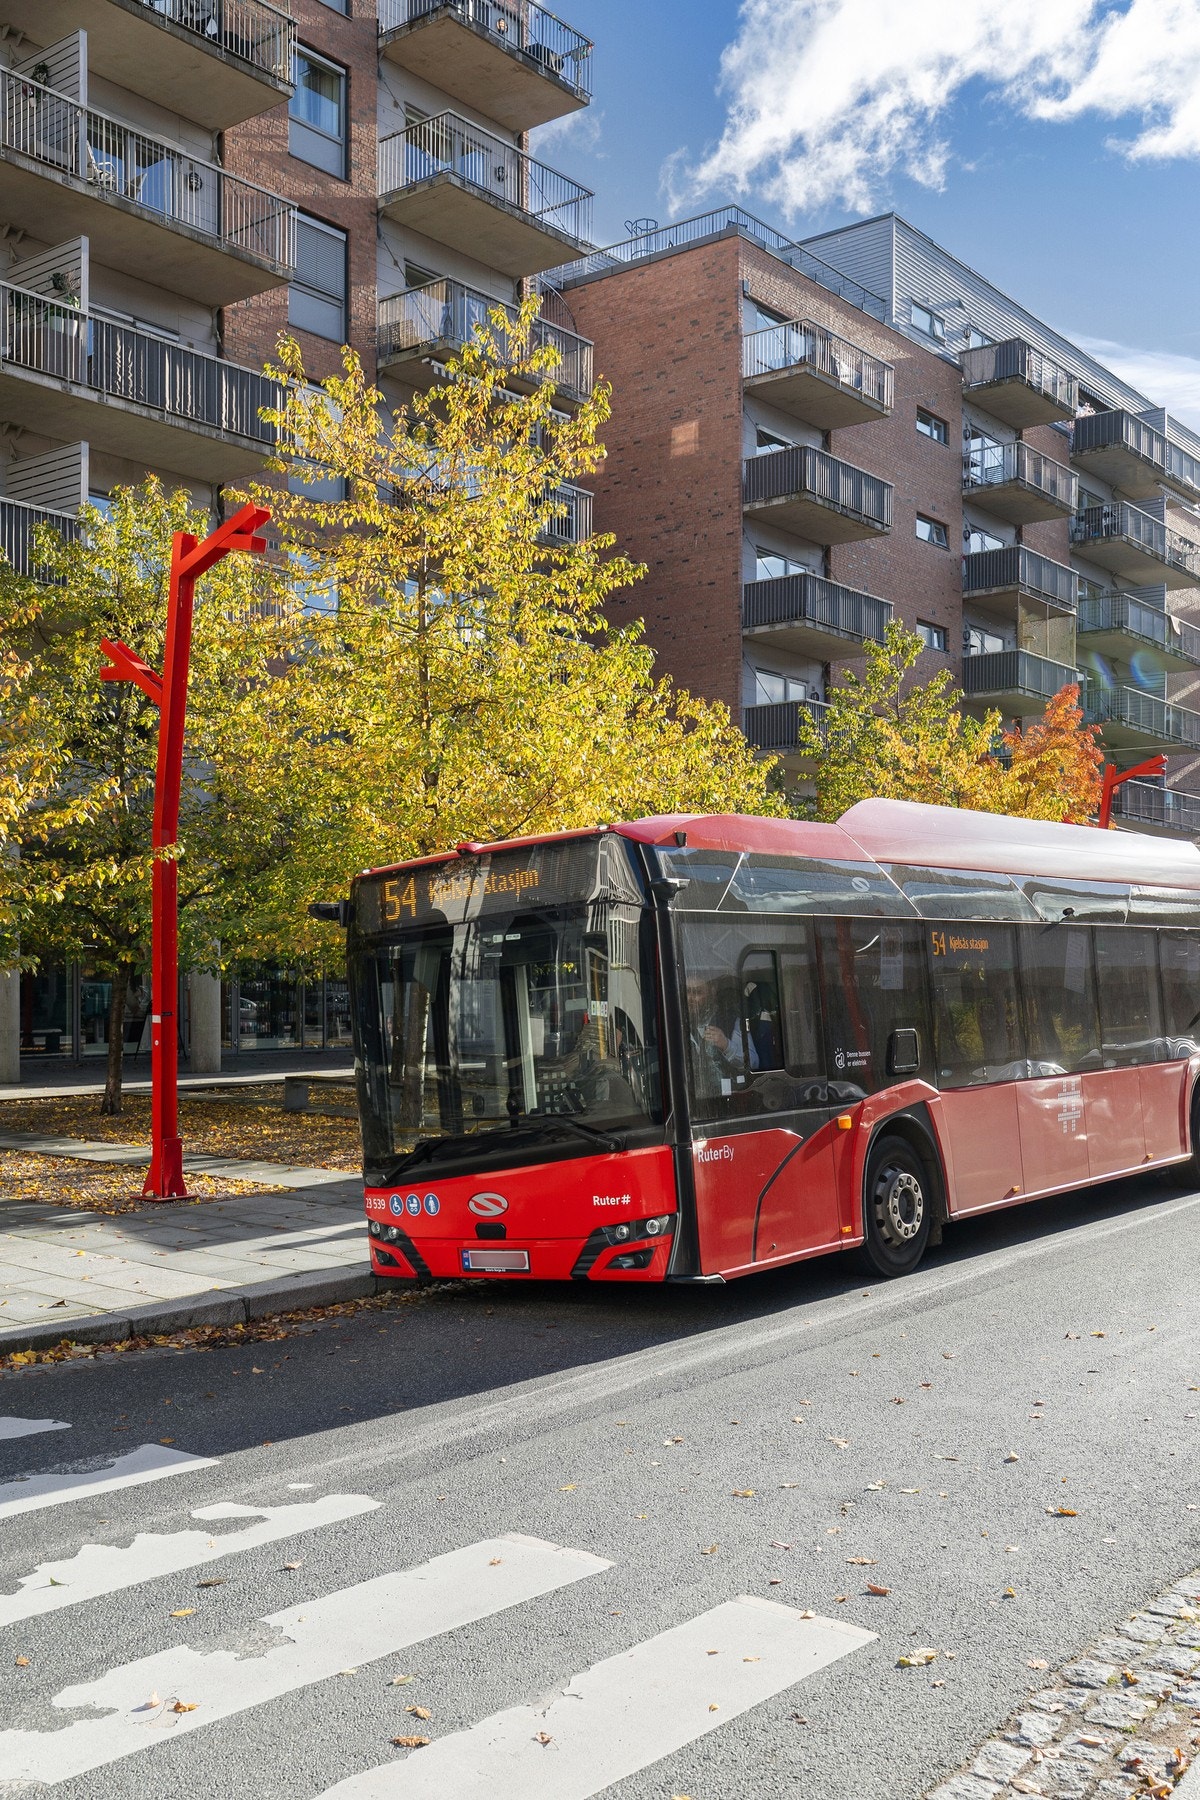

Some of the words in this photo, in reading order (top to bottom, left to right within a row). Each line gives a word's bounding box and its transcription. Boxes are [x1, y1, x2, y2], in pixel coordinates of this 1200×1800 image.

[384, 877, 417, 921] 54
[484, 868, 539, 897] stasjon
[931, 931, 947, 956] 54
[969, 936, 989, 953] stasjon
[852, 1058, 867, 1067] elektrisk
[697, 1144, 735, 1163] RuterBy
[365, 1197, 372, 1209] 23
[373, 1198, 386, 1210] 539
[592, 1194, 631, 1206] Ruter#
